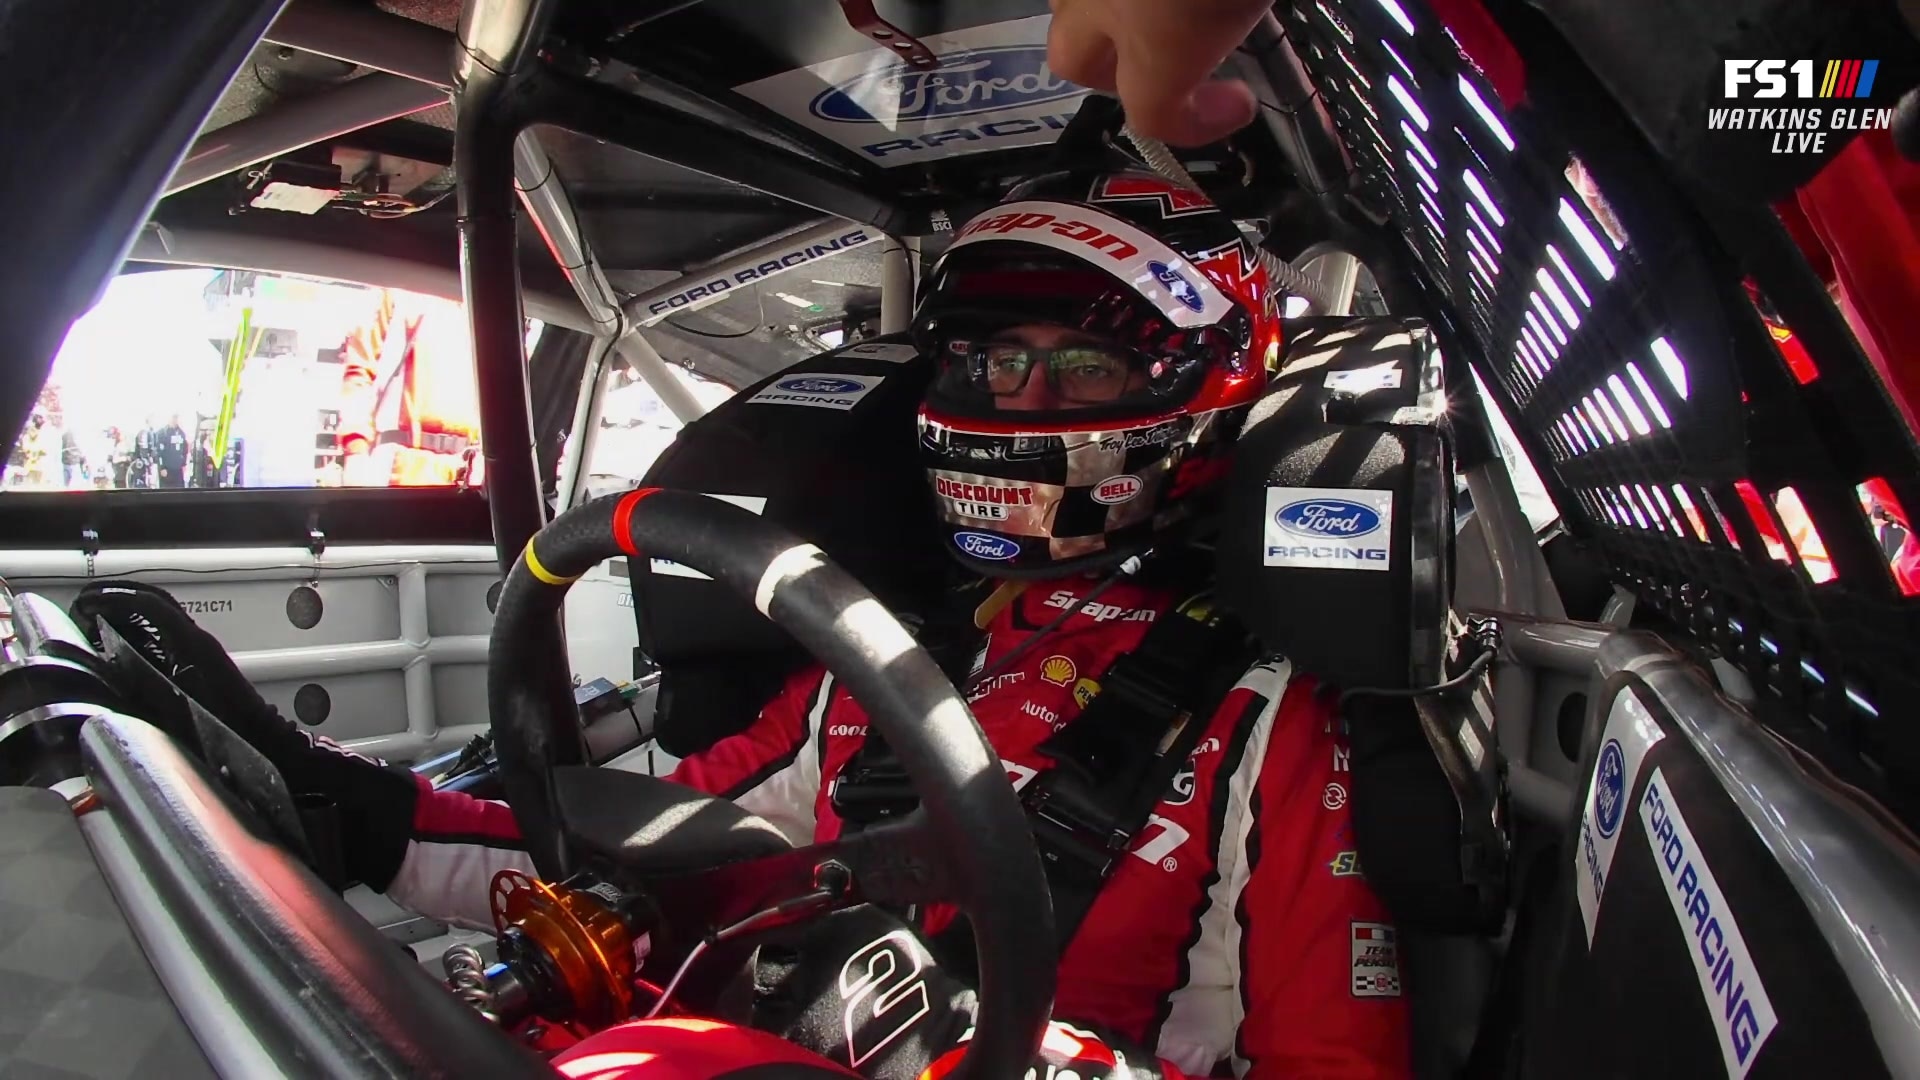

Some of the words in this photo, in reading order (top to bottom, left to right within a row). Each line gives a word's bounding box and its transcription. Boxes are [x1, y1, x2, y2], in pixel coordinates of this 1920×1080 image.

[649, 279, 731, 315] FORD
[734, 230, 869, 284] RACING
[790, 379, 848, 391] Ford
[754, 394, 855, 406] RACING
[936, 477, 1043, 506] DISCOUNT
[1100, 482, 1136, 498] BELL
[958, 502, 1001, 518] TIRE
[1295, 504, 1361, 532] Ford
[965, 535, 1005, 557] Ford
[1268, 546, 1386, 561] RACING
[1597, 752, 1619, 824] Ford
[1644, 782, 1684, 876] FORD
[1676, 860, 1760, 1067] RACING
[839, 930, 930, 1068] 2
